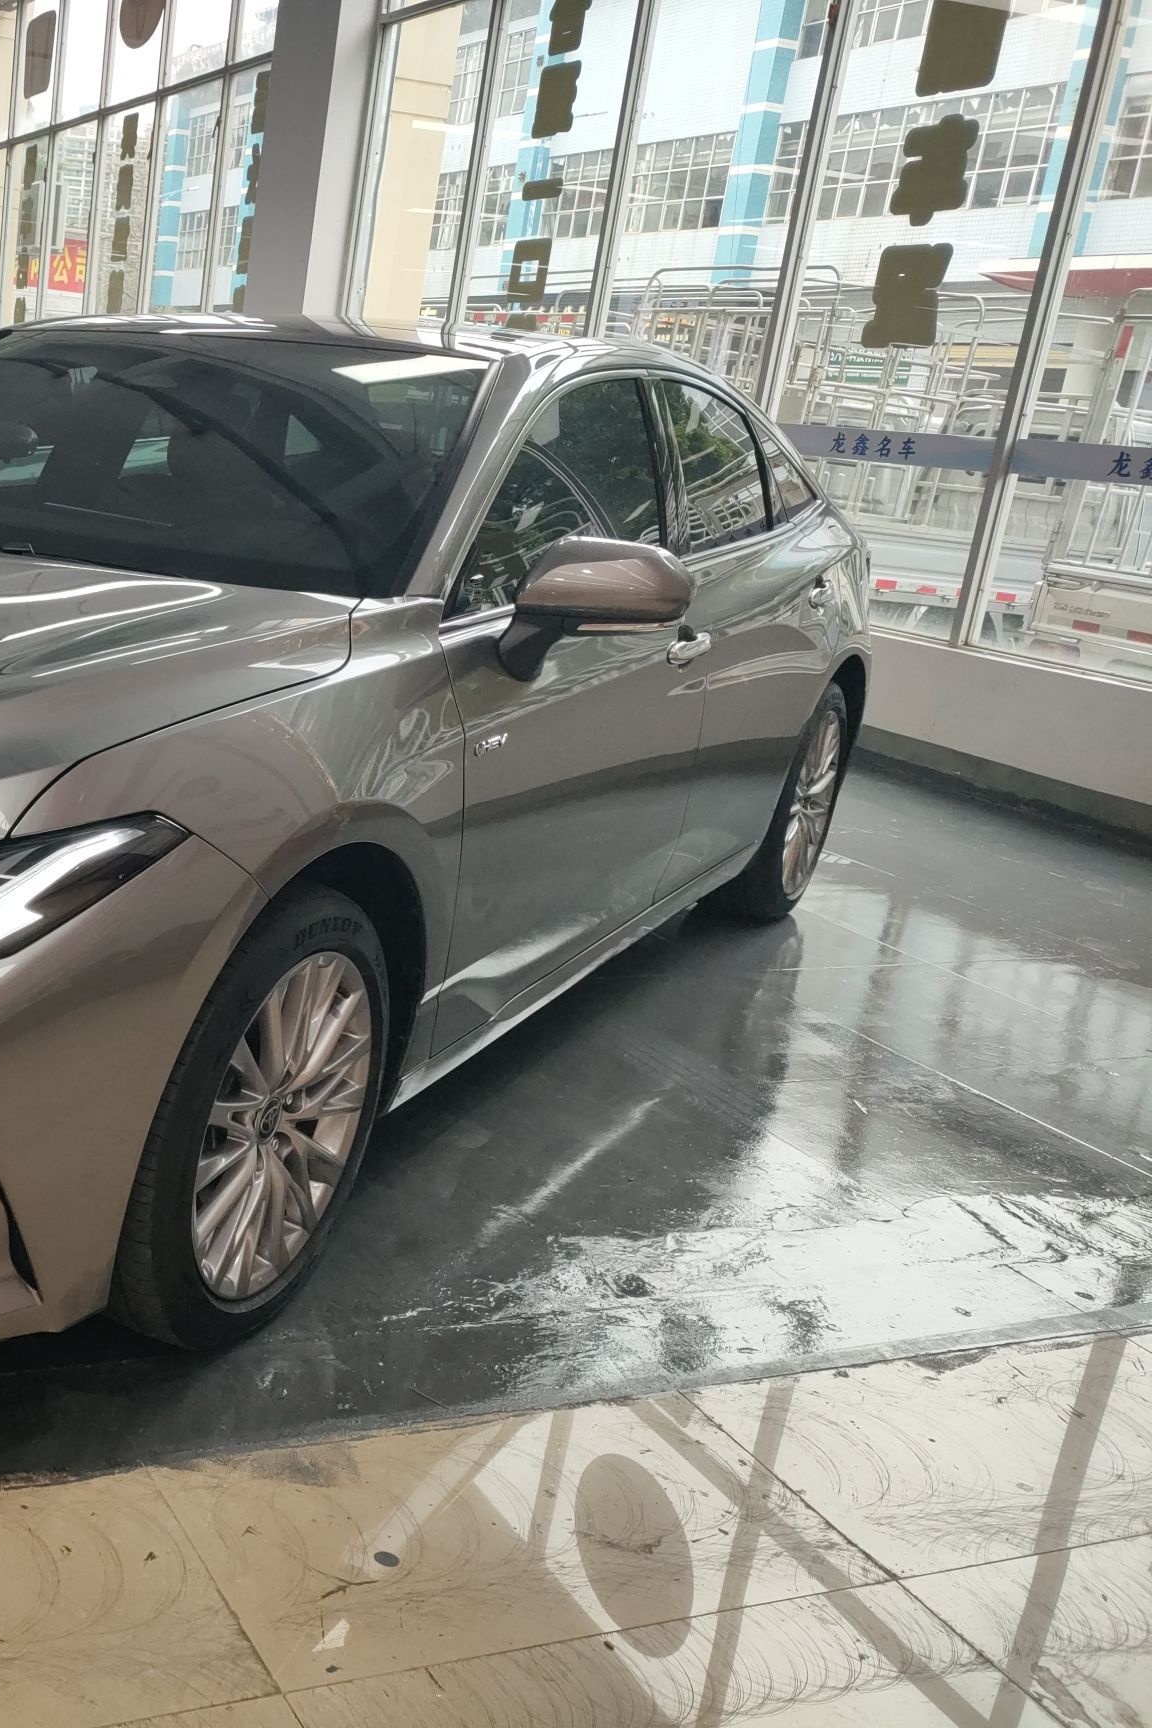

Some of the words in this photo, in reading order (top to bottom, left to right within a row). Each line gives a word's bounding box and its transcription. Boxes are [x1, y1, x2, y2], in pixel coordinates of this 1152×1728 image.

[829, 432, 916, 460] 龙鑫名车
[294, 916, 363, 951] DUNLOP
